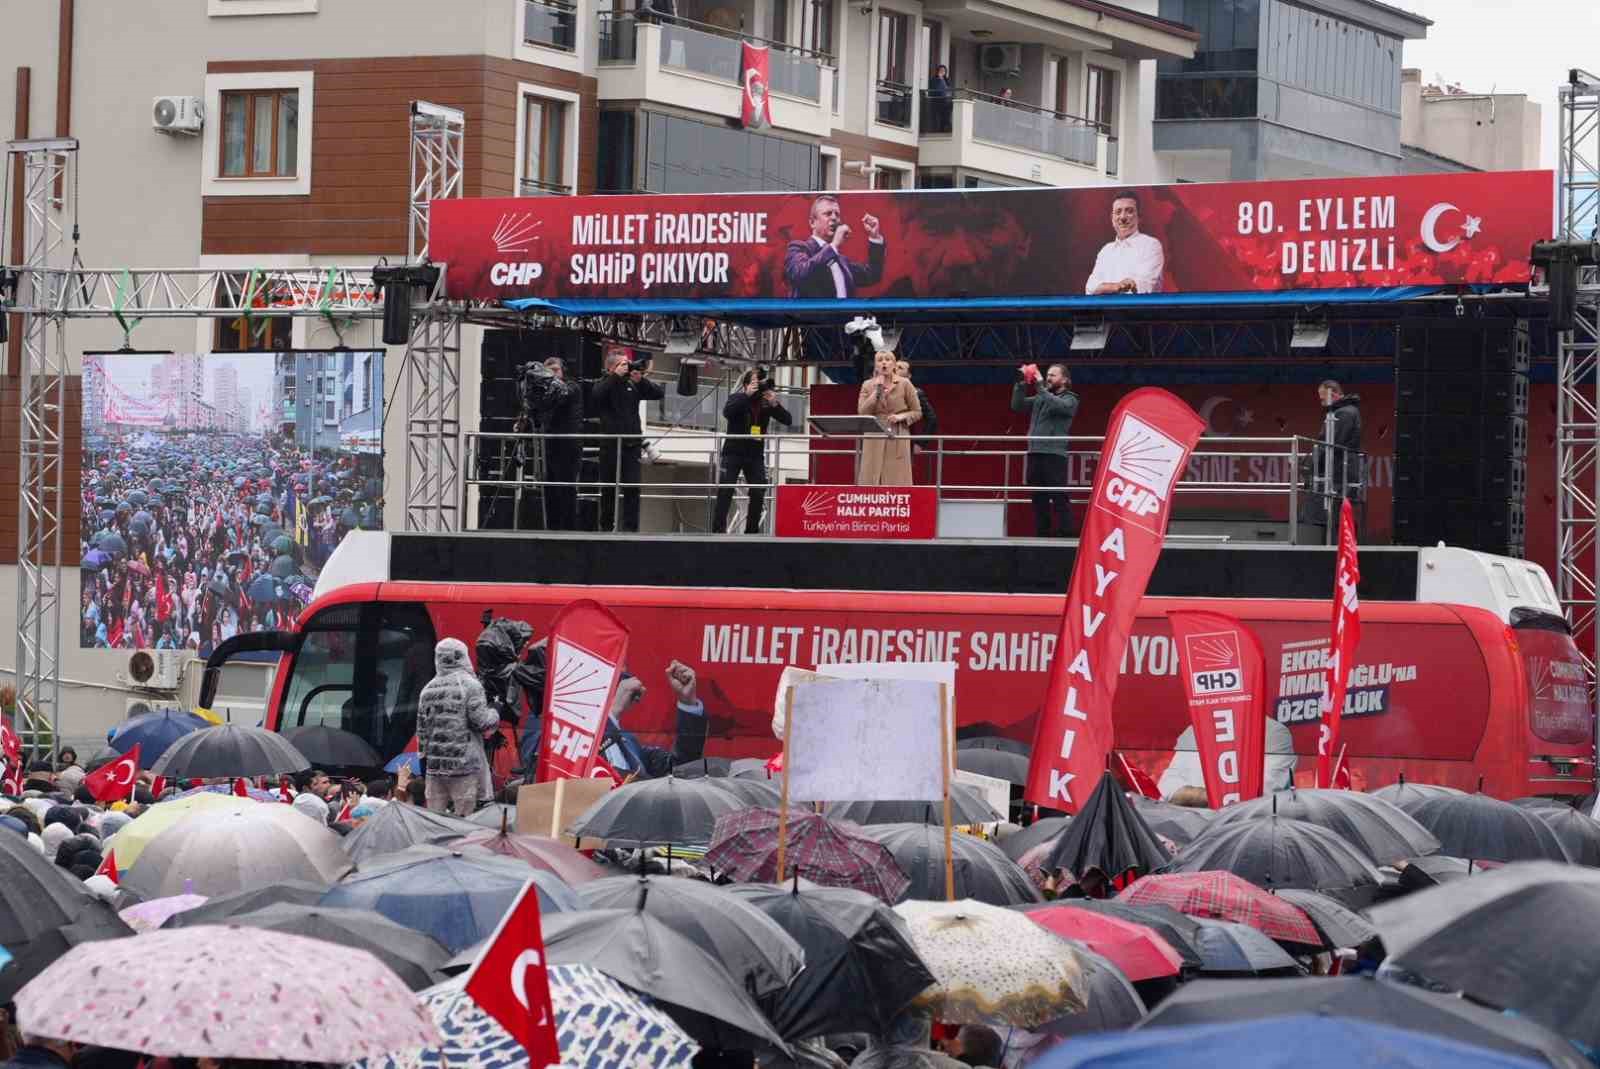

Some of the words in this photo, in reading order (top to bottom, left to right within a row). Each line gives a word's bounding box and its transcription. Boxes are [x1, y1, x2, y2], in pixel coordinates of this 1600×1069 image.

[1237, 200, 1284, 235] 80.
[1299, 195, 1396, 232] EYLEM
[490, 262, 543, 286] CHP
[640, 251, 729, 290] ÇIKIYOR
[837, 491, 911, 505] CUMHURİYET
[1105, 477, 1161, 518] CHP
[836, 505, 866, 518] HALK
[868, 504, 911, 518] PARTİSİ
[801, 519, 850, 533] Türkiye'nin
[851, 521, 879, 532] Birinci
[881, 520, 911, 532] Partisi
[1048, 526, 1127, 804] AYVALIK
[1281, 648, 1332, 673] EKRE
